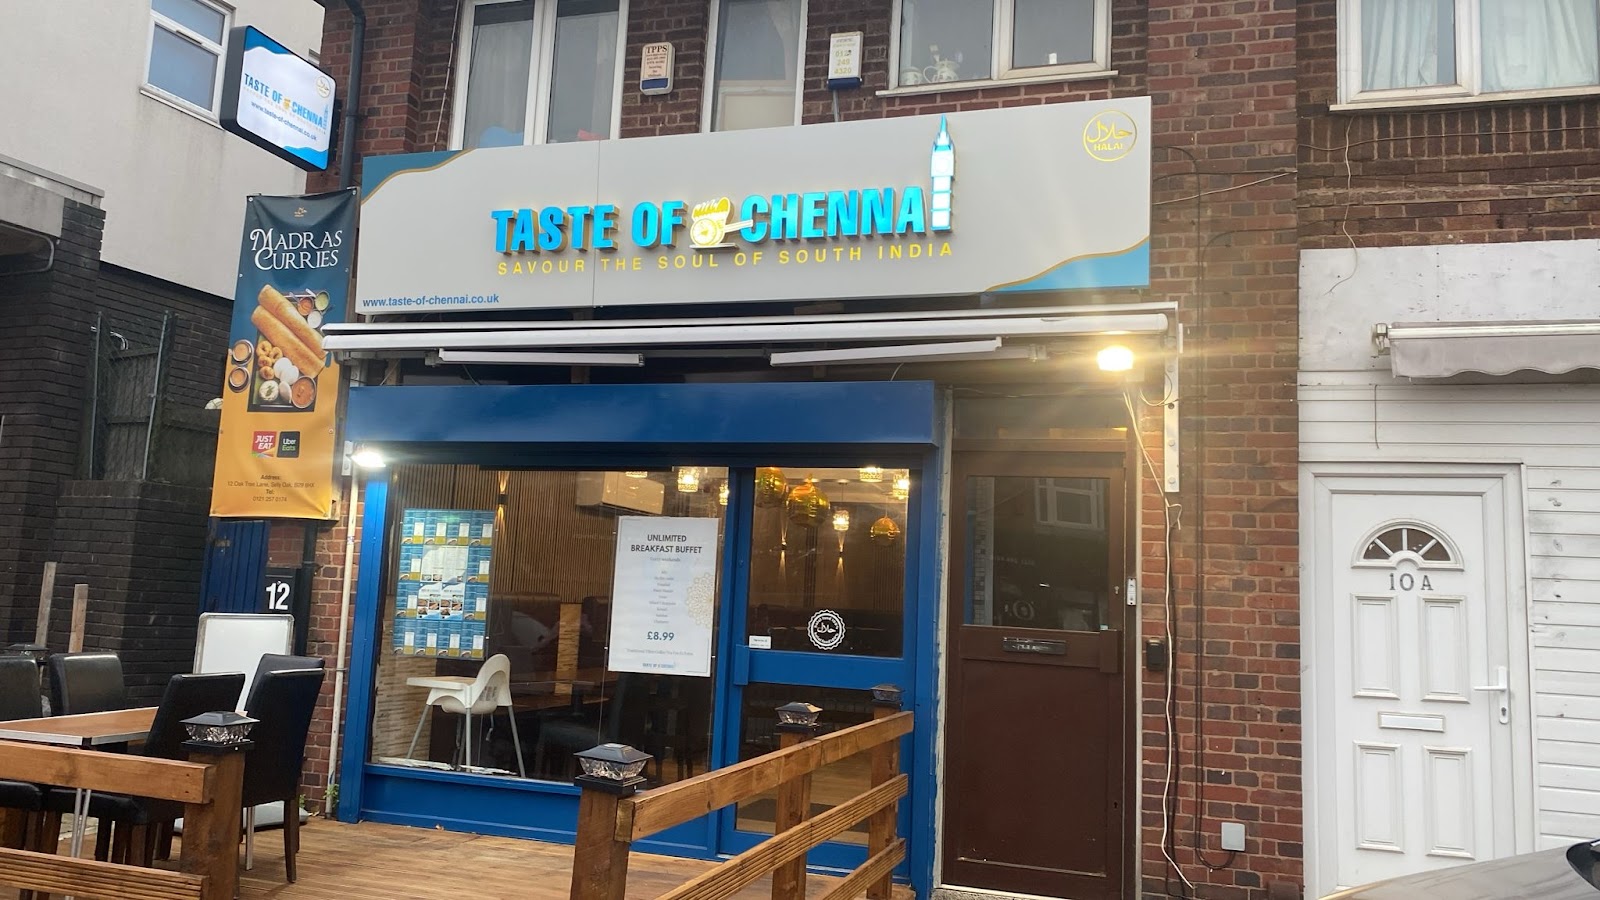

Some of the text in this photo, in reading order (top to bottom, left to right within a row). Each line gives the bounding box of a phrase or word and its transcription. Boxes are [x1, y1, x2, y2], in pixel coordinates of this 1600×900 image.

[646, 45, 668, 54] TPPS
[245, 73, 270, 97] TASTE
[272, 90, 283, 104] OF
[491, 203, 619, 254] TASTE
[631, 200, 688, 249] OF
[250, 228, 343, 251] MADRAS
[254, 247, 339, 270] CURRIES
[497, 242, 952, 276] SAVOUR THE SOUL OF SOUTH INDIA
[362, 293, 500, 307] www.taste-of-chennai.co.uk
[255, 435, 274, 443] JUST
[258, 442, 273, 450] EAT
[647, 534, 687, 542] UNLIMITED
[631, 544, 702, 554] BREAKFAST BUFFET
[266, 582, 290, 610] 12
[646, 631, 675, 641] £8.99
